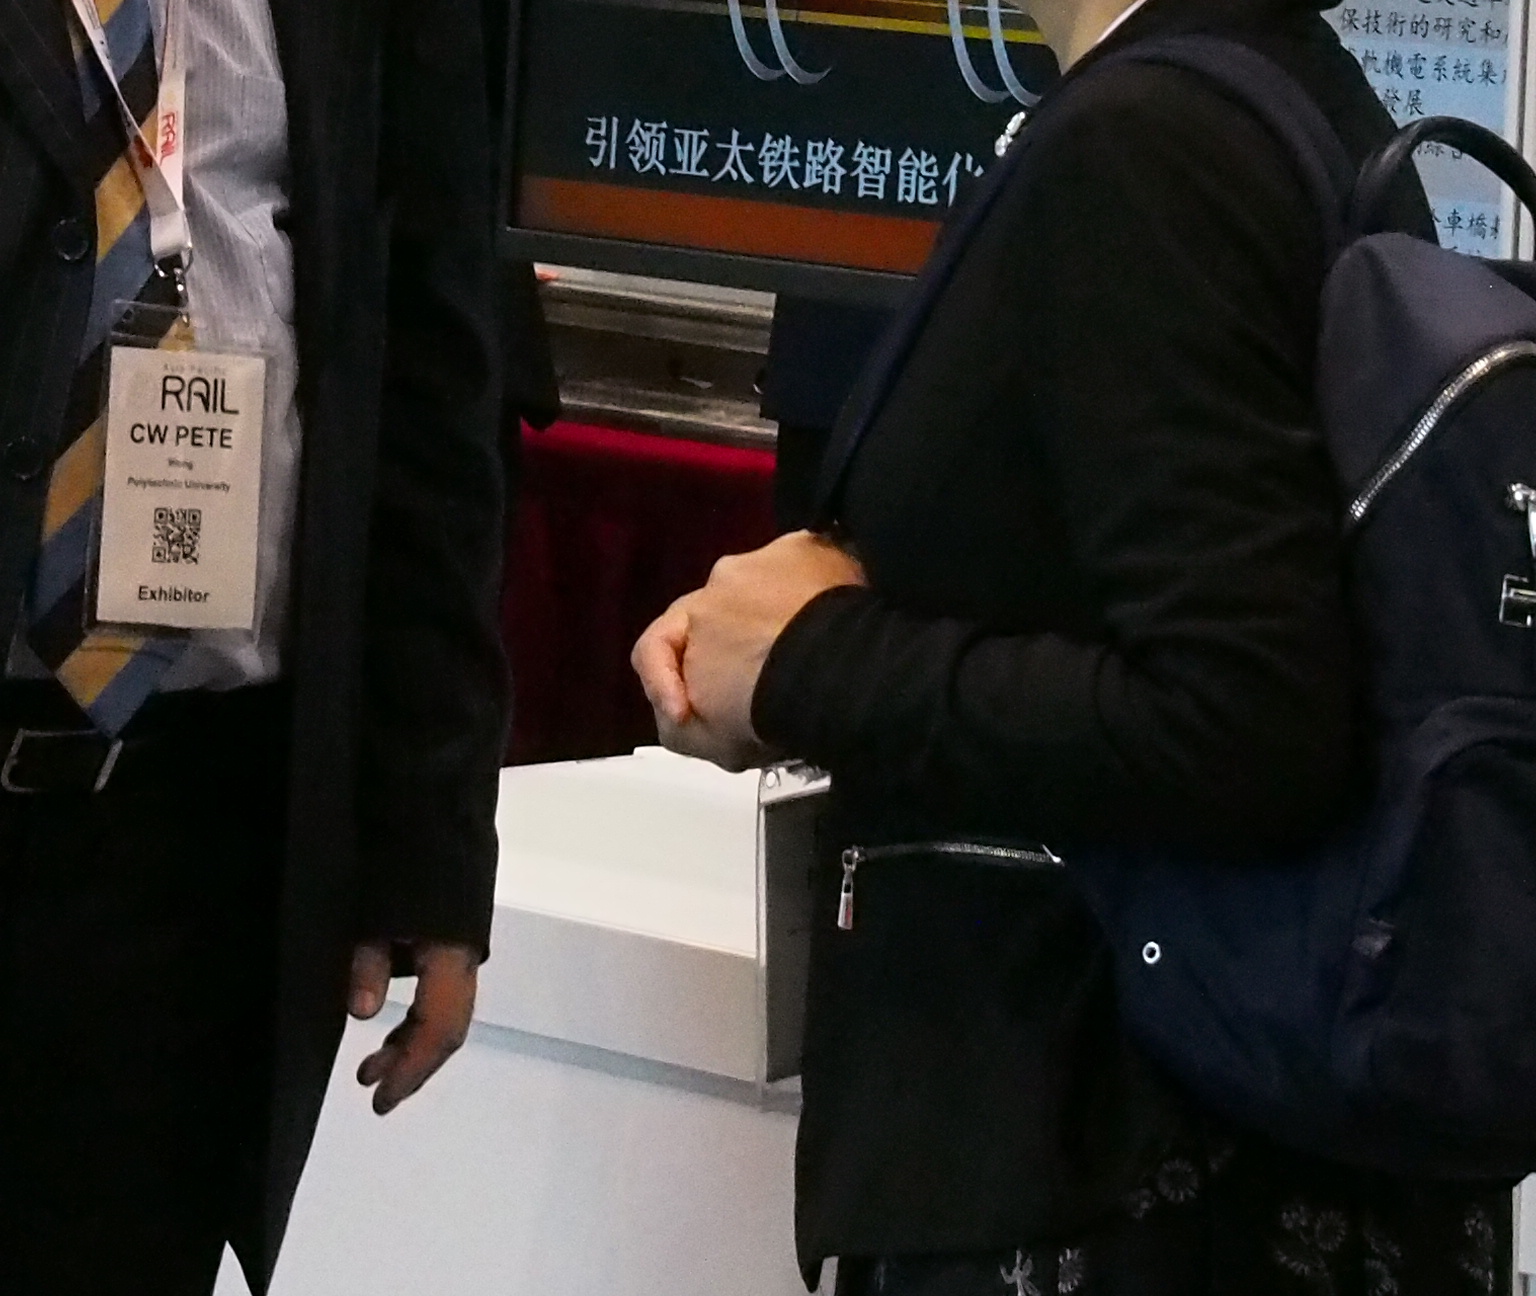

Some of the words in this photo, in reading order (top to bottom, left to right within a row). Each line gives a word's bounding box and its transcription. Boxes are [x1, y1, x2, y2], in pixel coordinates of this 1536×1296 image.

[1342, 8, 1508, 44] 保技術的研究和
[161, 375, 240, 415] RAIL
[130, 422, 168, 444] CW
[175, 426, 233, 449] PETE
[138, 585, 210, 603] Exhibitor
